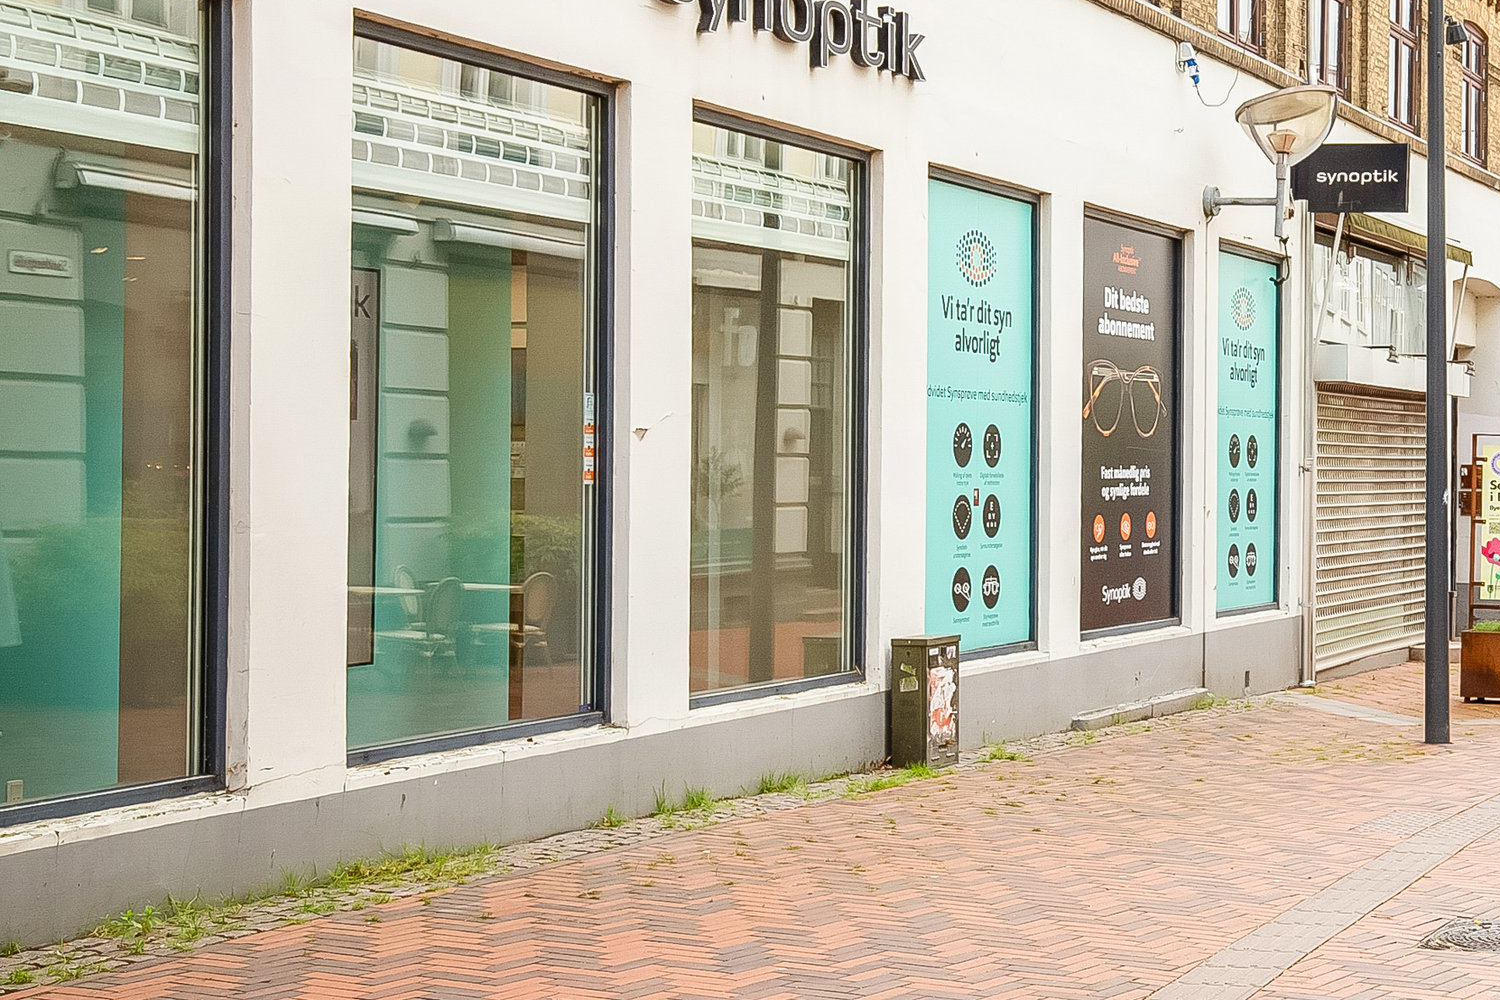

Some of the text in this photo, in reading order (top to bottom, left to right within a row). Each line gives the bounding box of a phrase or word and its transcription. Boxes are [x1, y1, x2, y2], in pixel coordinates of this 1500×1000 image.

[1316, 169, 1399, 186] synoptik
[941, 294, 953, 320] Vi
[976, 299, 992, 326] dit
[993, 309, 1012, 334] syn
[1104, 286, 1150, 315] Dit bedste
[1098, 312, 1155, 342] abonnement
[954, 327, 1001, 363] alvorligt
[1253, 347, 1265, 366] syn
[1229, 361, 1258, 388] alvorligt
[1490, 491, 1493, 502] i
[1102, 582, 1131, 605] Synoptik
